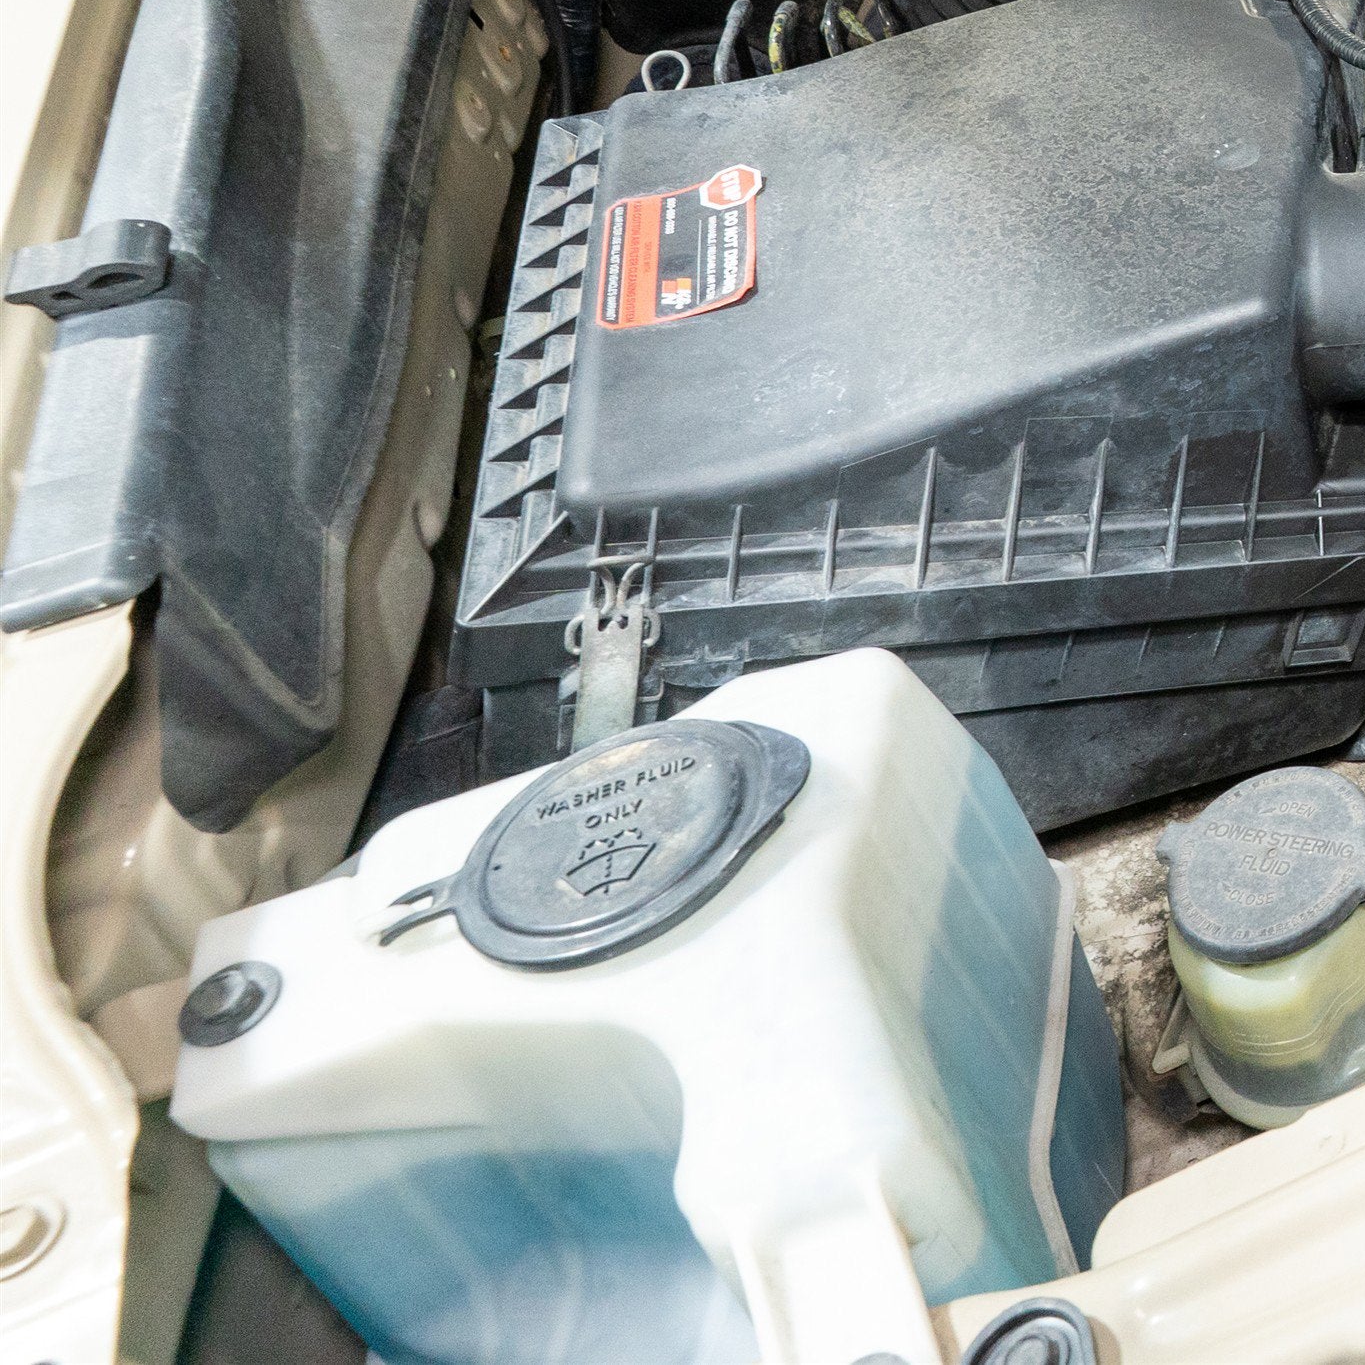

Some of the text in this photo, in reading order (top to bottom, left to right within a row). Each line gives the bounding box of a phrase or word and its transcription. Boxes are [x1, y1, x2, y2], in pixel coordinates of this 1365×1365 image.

[721, 169, 743, 201] STOP
[722, 210, 738, 294] DO NOT DISCARD
[537, 756, 697, 820] WASHER FLUID
[585, 798, 643, 830] ONLY
[1279, 800, 1318, 819] OPEN
[1203, 821, 1356, 858] POWER STEERING
[1238, 854, 1292, 877] FLUID
[1229, 888, 1276, 906] CLOSE
